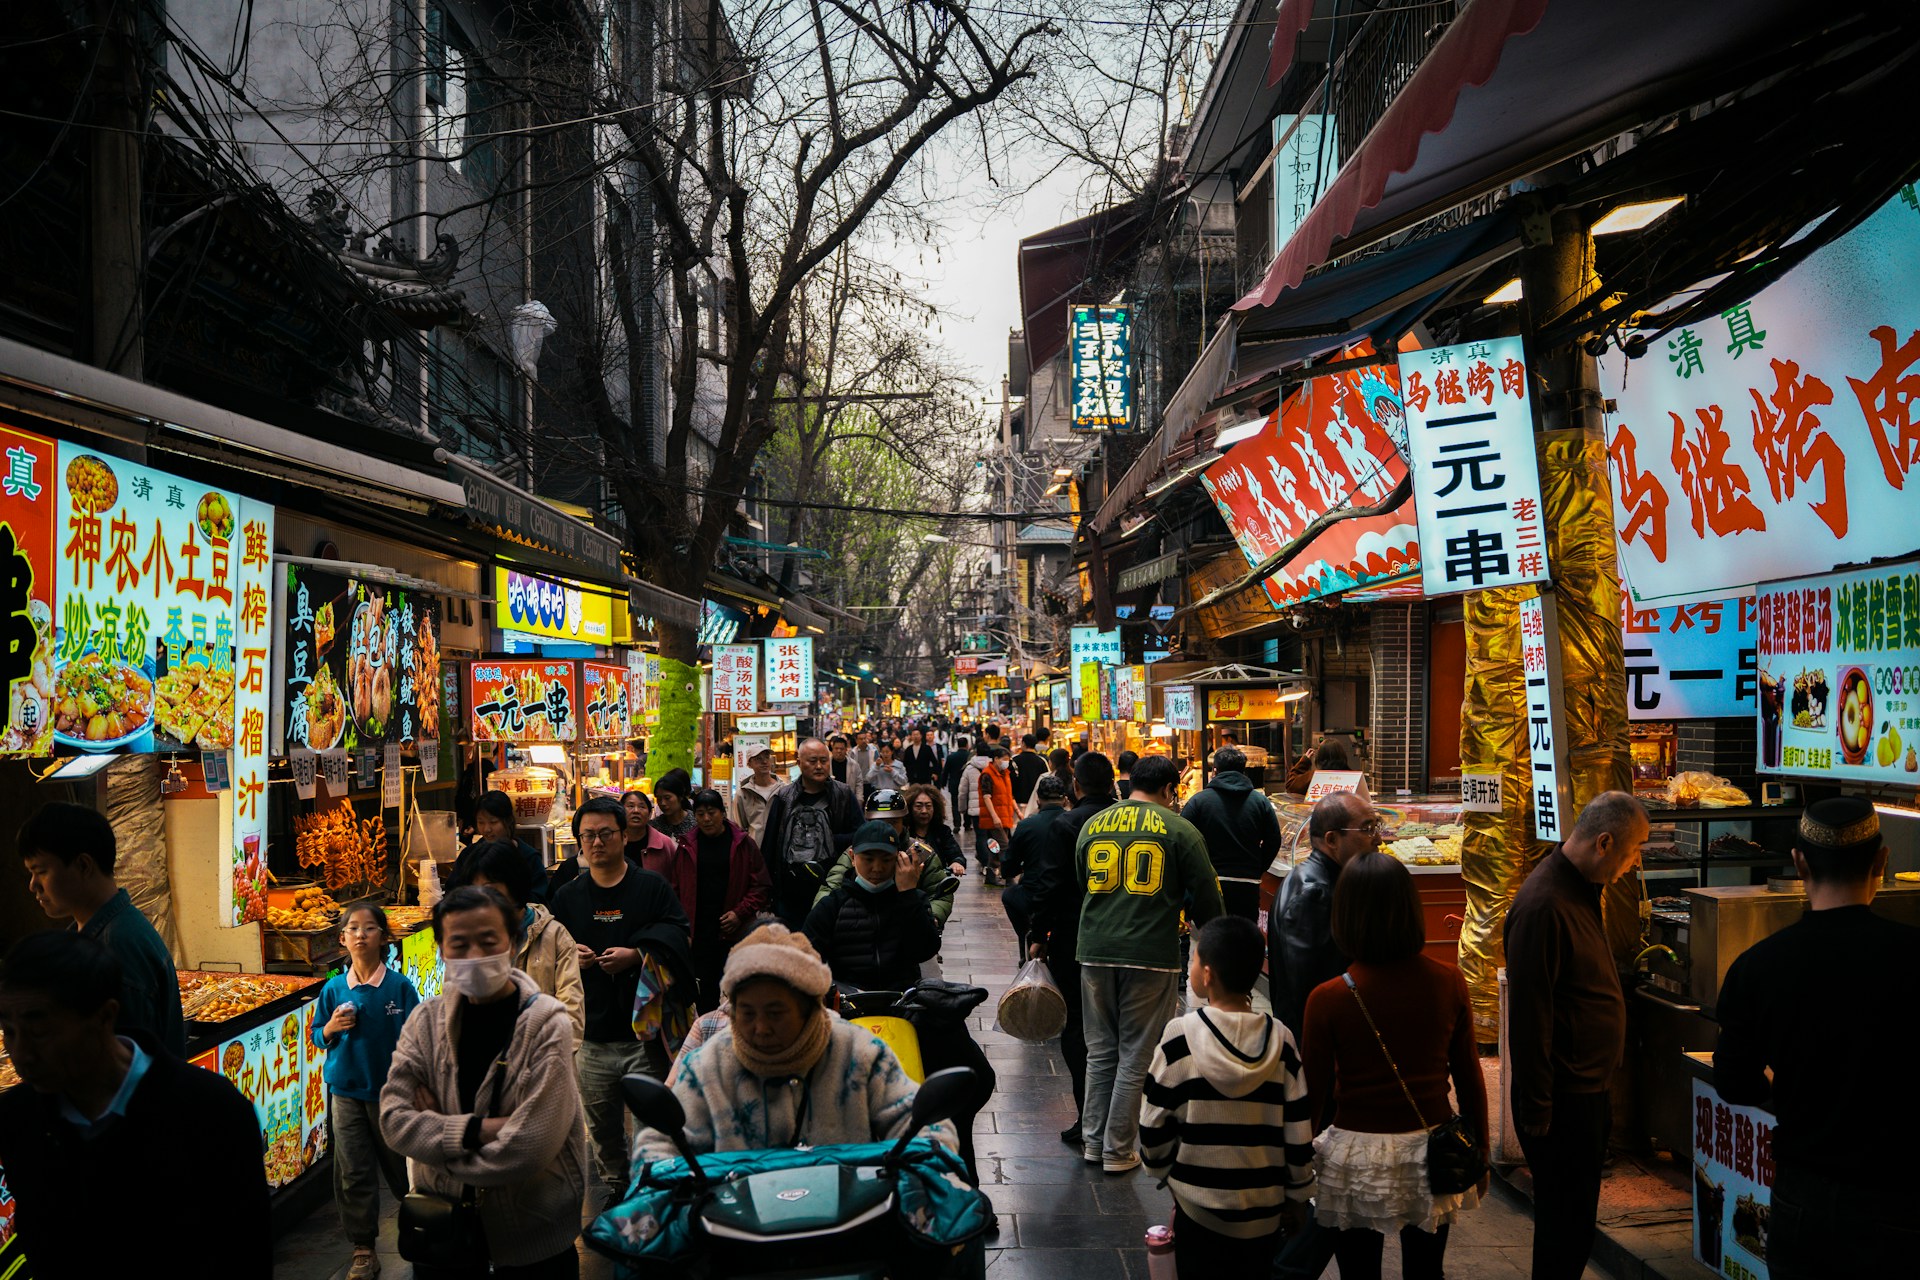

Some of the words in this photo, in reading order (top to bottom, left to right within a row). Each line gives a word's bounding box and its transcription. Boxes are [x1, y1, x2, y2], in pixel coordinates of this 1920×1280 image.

[1430, 343, 1491, 365] 清真
[1668, 301, 1767, 379] 清真
[1404, 358, 1525, 413] 马继烤肉
[132, 475, 186, 510] 清真
[1425, 412, 1509, 585] 一元一串
[65, 496, 233, 607] 神农小土豆
[1513, 498, 1543, 577] 老三样
[60, 592, 151, 669] 炒凉粉
[163, 606, 235, 673] 香豆腐
[1759, 586, 1832, 656] 现熬酸梅汤
[1836, 573, 1920, 653] 冰糖烤雪梨
[238, 519, 268, 821] 鲜榨石榴汁
[287, 581, 315, 747] 臭豆腐
[400, 602, 417, 743] 铁板鱿鱼
[779, 645, 800, 698] 张庆烤肉
[1072, 642, 1119, 652] 老米家泡馍
[475, 679, 569, 740] 一元一串
[587, 682, 628, 736] 一元一串
[736, 656, 753, 711] 酸汤水饺
[499, 778, 529, 792] 冰镇
[1528, 678, 1556, 837] 一元一串
[1462, 778, 1500, 804] 空调开放
[1088, 806, 1140, 836] GOLDEN
[1141, 808, 1168, 836] AGE
[1087, 840, 1166, 896] 90
[250, 1026, 276, 1053] 清真
[266, 1088, 302, 1146] 香豆腐
